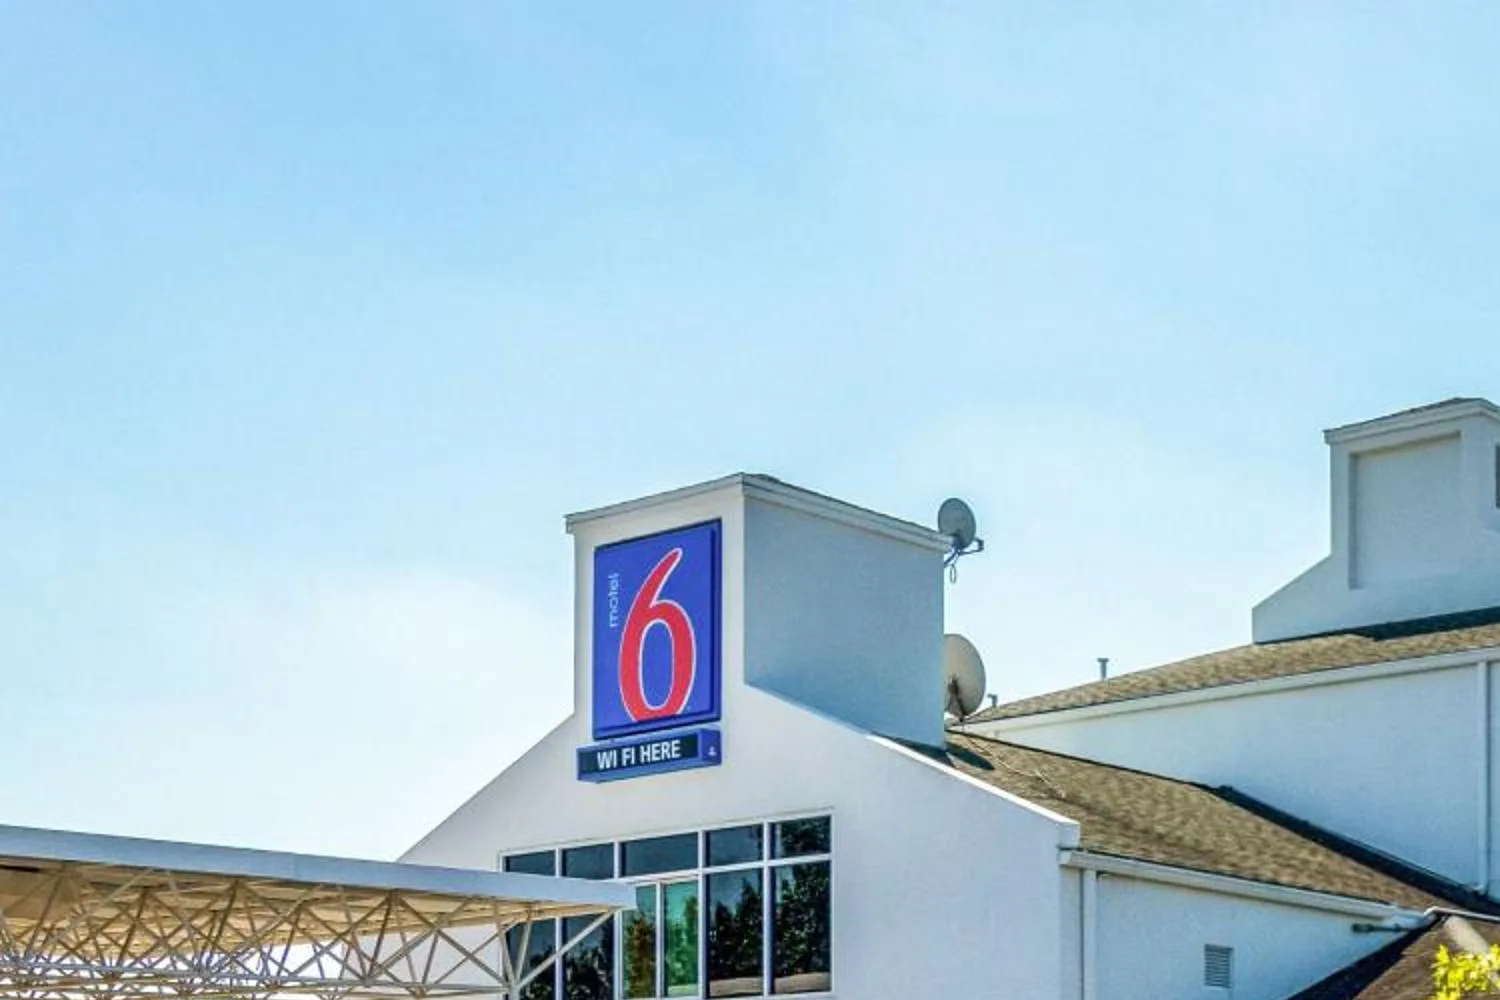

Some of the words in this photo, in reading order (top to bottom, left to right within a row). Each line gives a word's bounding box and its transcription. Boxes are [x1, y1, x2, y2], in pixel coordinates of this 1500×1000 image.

[607, 572, 620, 629] motel
[618, 547, 697, 722] 6
[597, 749, 617, 771] WI
[621, 747, 635, 767] FI
[640, 740, 681, 764] HERE
